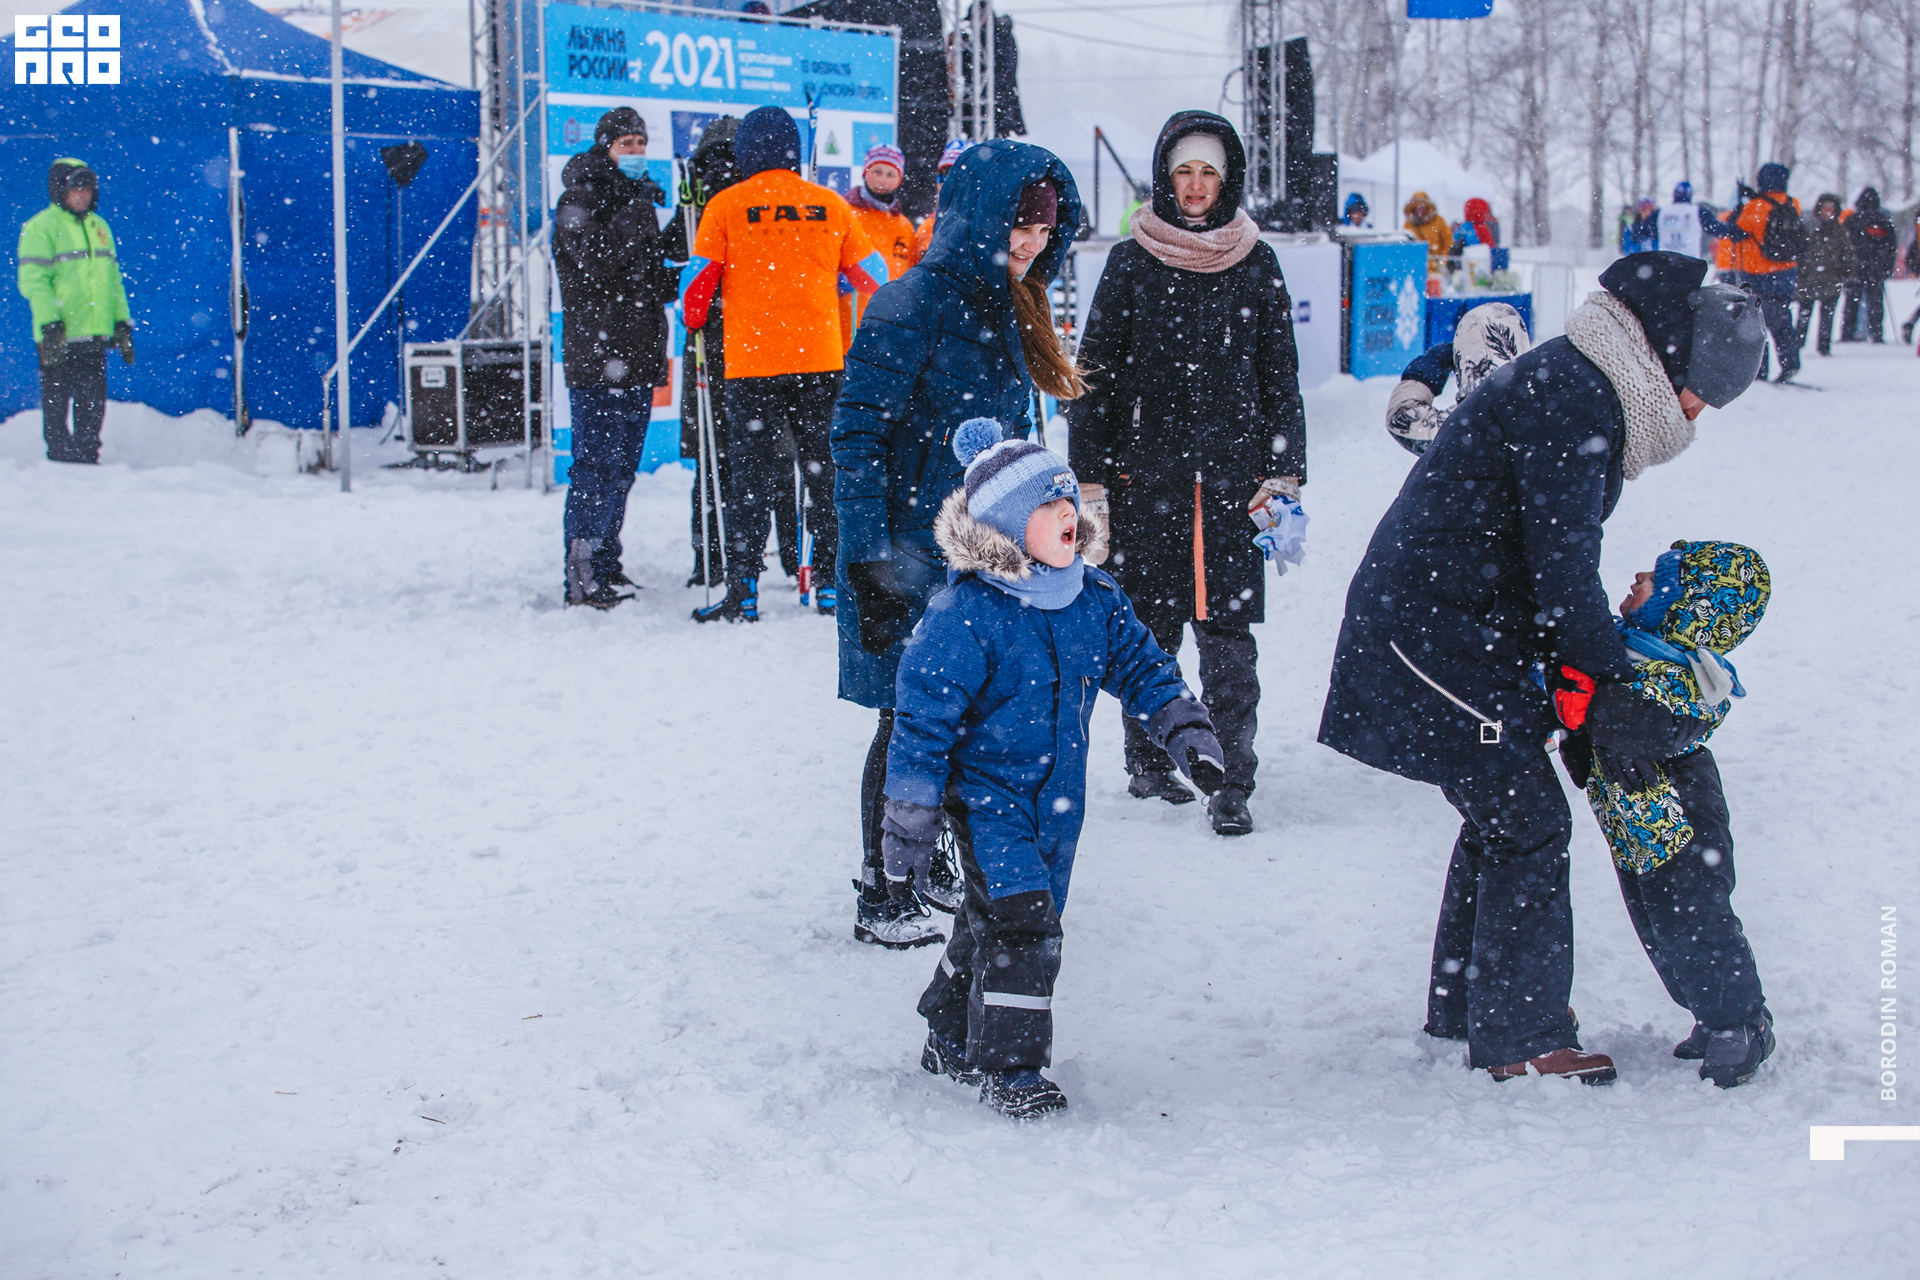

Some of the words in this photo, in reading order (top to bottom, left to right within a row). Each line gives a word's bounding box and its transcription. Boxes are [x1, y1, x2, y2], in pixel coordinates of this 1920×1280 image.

[568, 54, 629, 81] РОССИИ
[646, 30, 736, 89] 2021
[747, 205, 828, 223] ГАЗ
